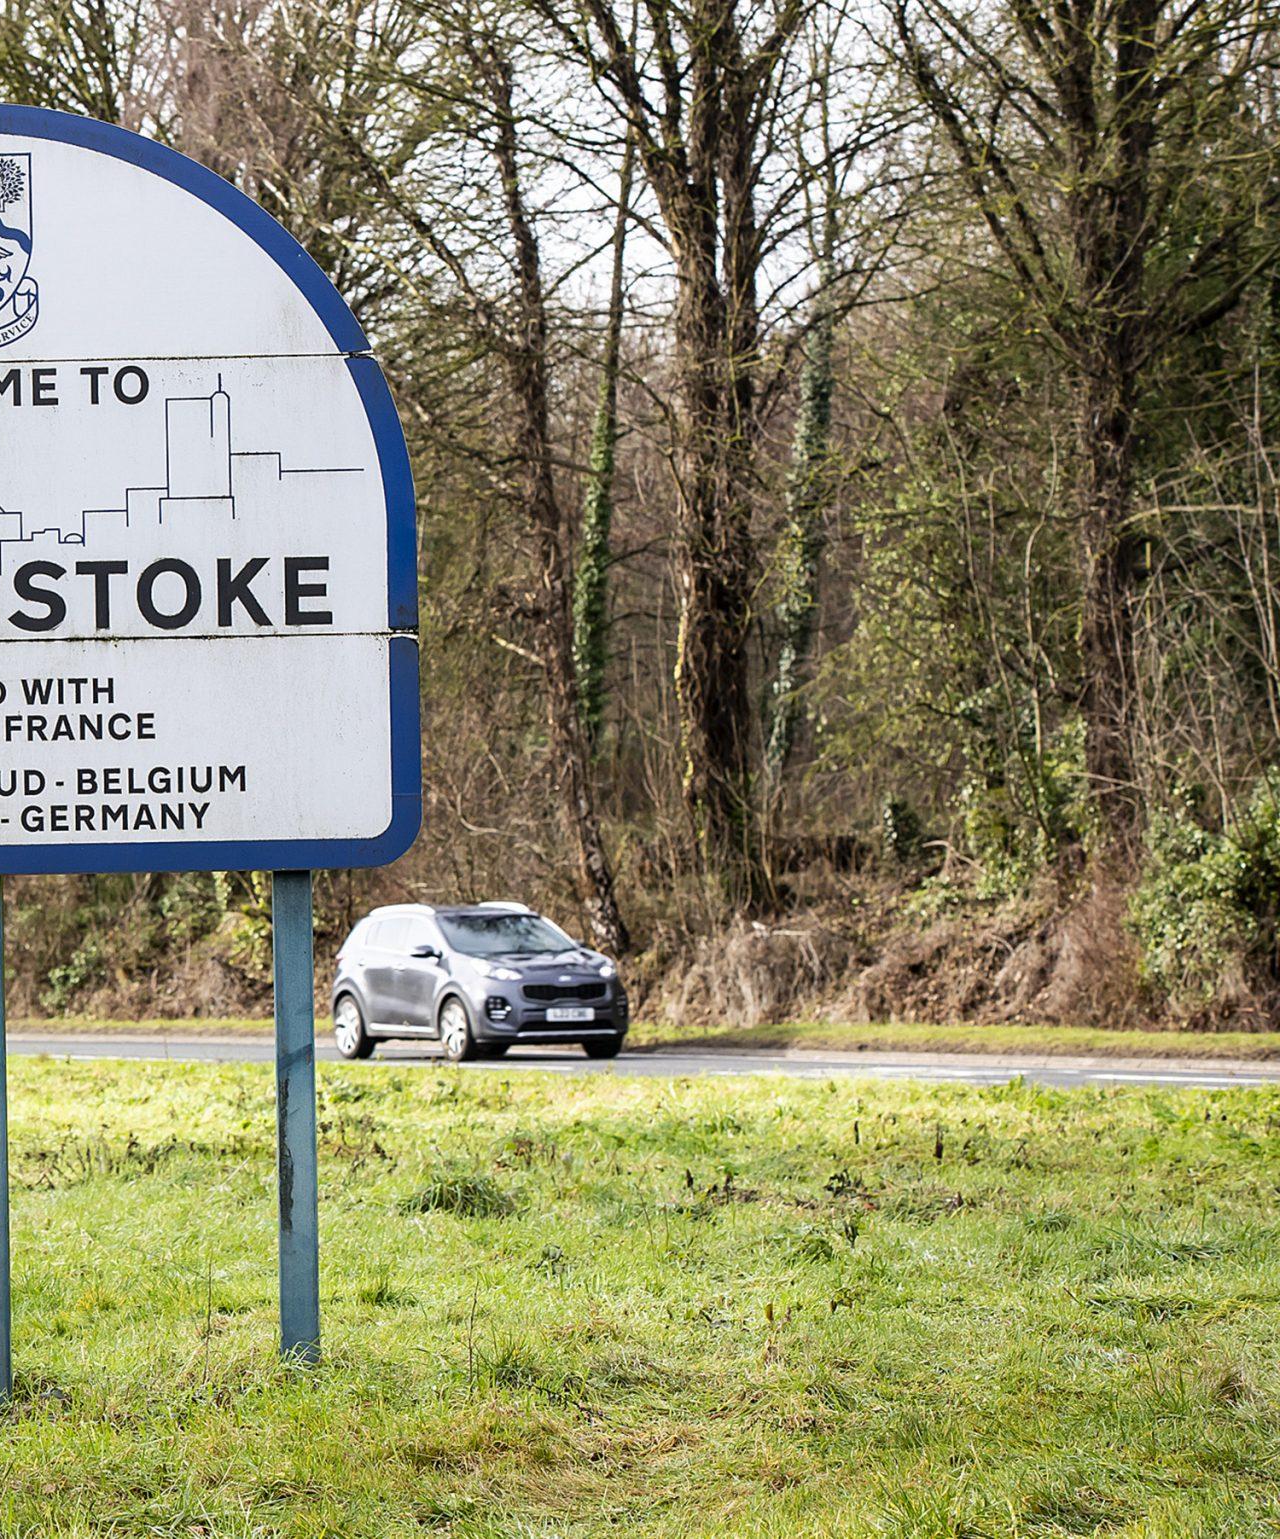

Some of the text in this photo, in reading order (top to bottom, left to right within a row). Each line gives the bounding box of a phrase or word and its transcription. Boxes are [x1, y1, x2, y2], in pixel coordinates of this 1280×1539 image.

[79, 365, 150, 406] TO
[20, 677, 115, 706] WITH
[5, 712, 156, 743] FRANCE
[76, 765, 246, 796] BELGIUM
[20, 802, 211, 833] GERMANY
